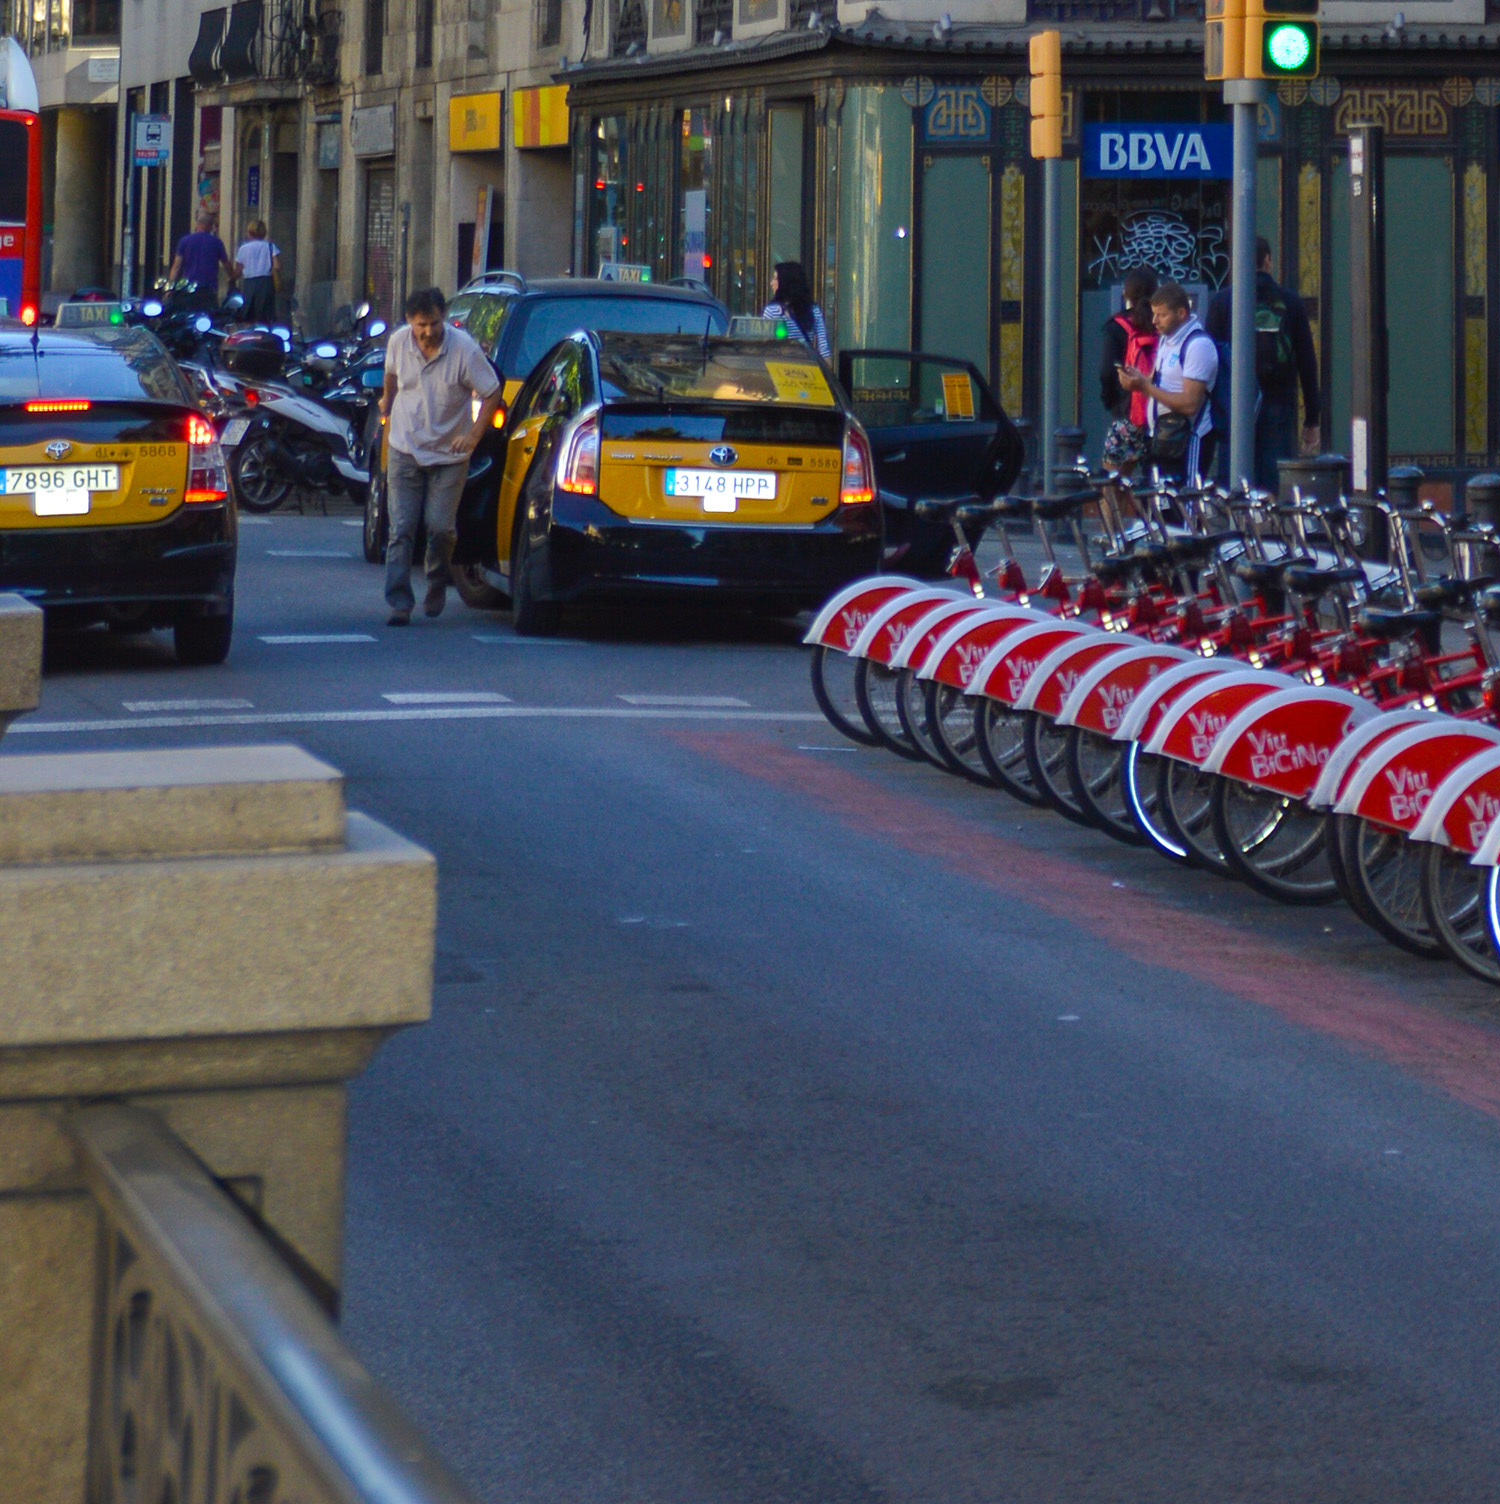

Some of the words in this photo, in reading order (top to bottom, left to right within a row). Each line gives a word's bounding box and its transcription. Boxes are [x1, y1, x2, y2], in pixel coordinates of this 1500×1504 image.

[1100, 133, 1212, 171] BBVA
[618, 268, 641, 282] TAXI
[80, 306, 109, 322] TAXI
[139, 445, 177, 458] 5868
[810, 458, 838, 468] 5580
[11, 471, 65, 491] 7896
[73, 469, 113, 488] GHT
[679, 475, 726, 492] 3148
[733, 478, 767, 495] HPP
[1098, 686, 1133, 708] Viu
[1187, 711, 1226, 735] Viu
[1247, 729, 1287, 755] Viu
[1386, 767, 1428, 795] Viu
